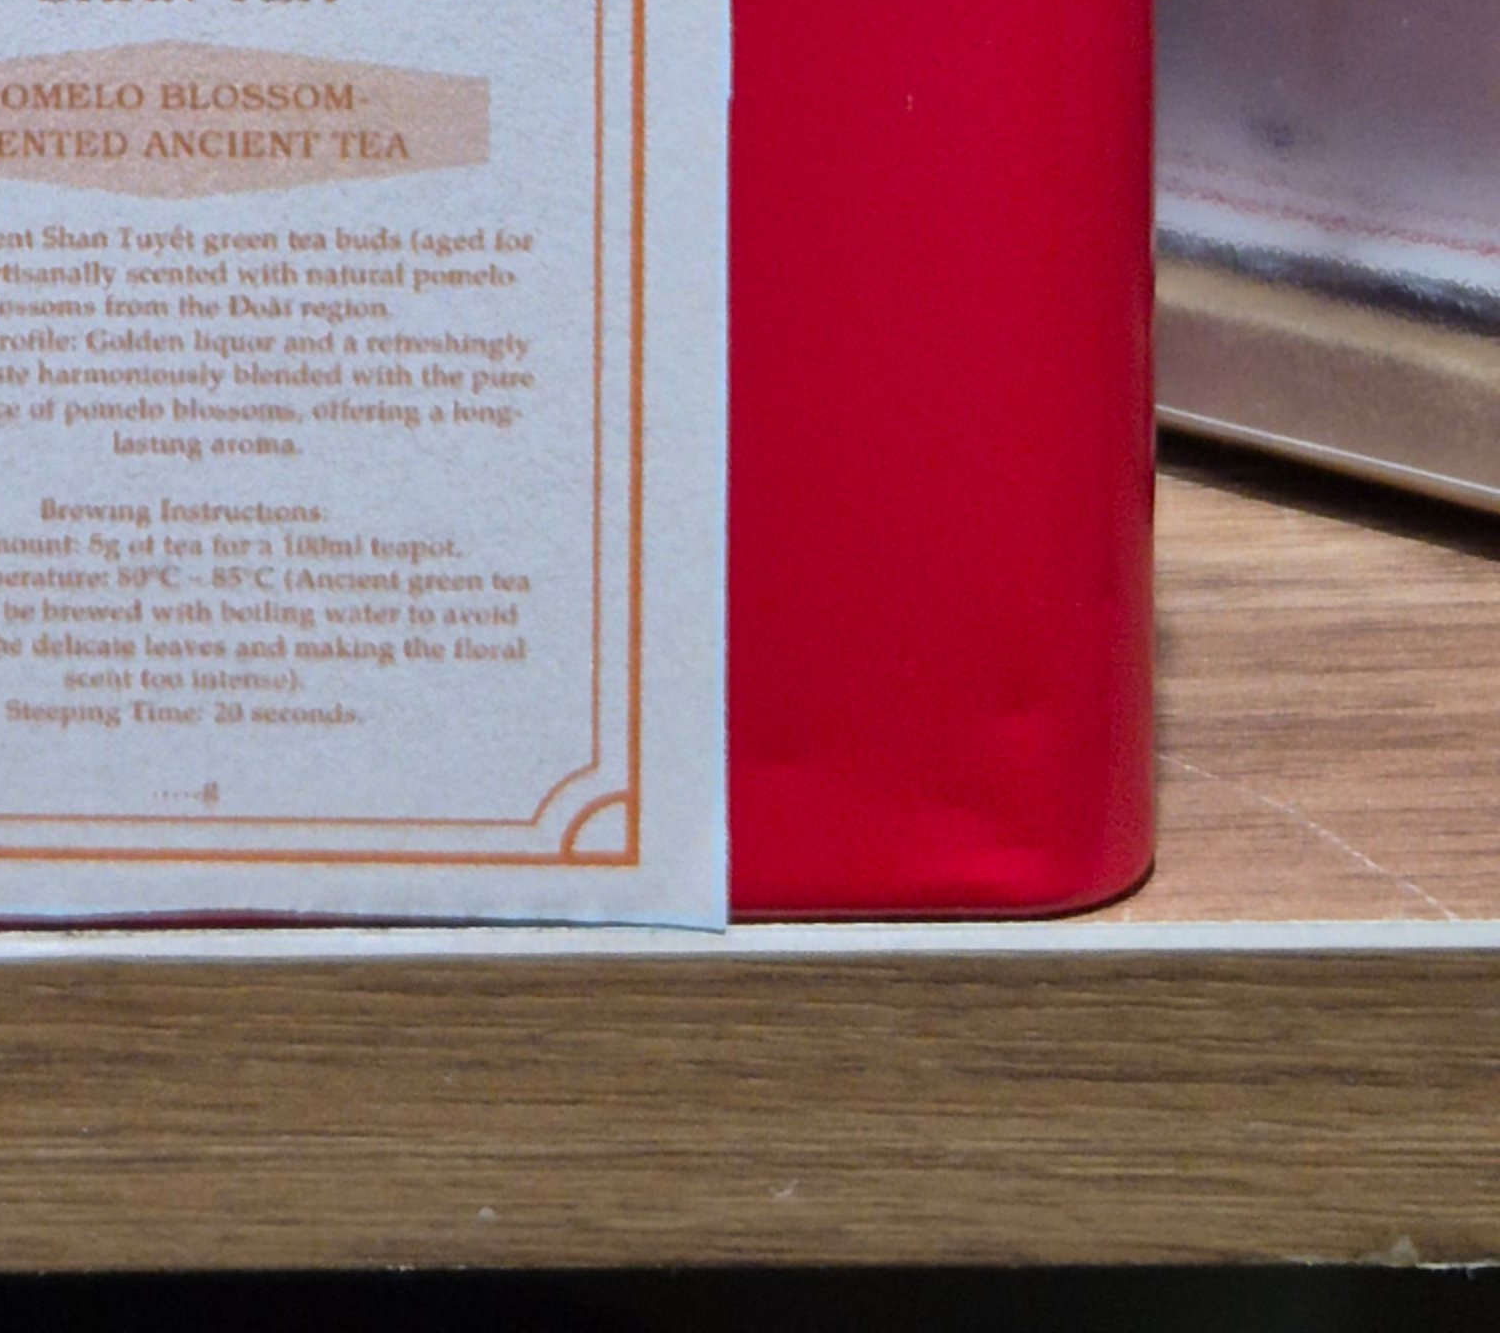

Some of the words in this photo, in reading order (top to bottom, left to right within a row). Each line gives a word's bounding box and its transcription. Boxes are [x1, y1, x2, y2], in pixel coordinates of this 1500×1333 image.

[159, 82, 371, 112] BLOSSOM-
[143, 129, 320, 160] ANCIENT
[336, 130, 411, 160] TEA
[42, 227, 109, 252] Shan
[204, 233, 278, 259] green
[288, 227, 327, 252] tea
[335, 228, 402, 253] buds
[410, 228, 485, 260] (aged
[494, 228, 534, 253] for
[125, 259, 227, 284] scented
[238, 260, 298, 285] with
[306, 260, 404, 285] natural
[413, 261, 516, 293] pomelo
[105, 293, 168, 318] from
[179, 293, 220, 318] the
[86, 328, 184, 353] Golden
[194, 329, 275, 361] liquor
[284, 329, 333, 354] and
[344, 335, 357, 354] a
[367, 330, 528, 362] refreshingly
[38, 361, 222, 393] harmoniously
[234, 362, 342, 387] blended
[353, 362, 412, 387] with
[422, 363, 464, 388] the
[471, 369, 534, 395] pure
[30, 396, 53, 421] of
[65, 396, 164, 428] pomelo
[312, 397, 420, 429] offering
[430, 404, 443, 423] a
[113, 431, 201, 463] lasting
[41, 498, 151, 530] Brewing
[128, 532, 154, 557] of
[164, 532, 202, 557] tea
[213, 533, 254, 558] for
[259, 539, 272, 558] a
[371, 534, 462, 566] teapot.
[283, 567, 400, 596] (Ancient
[408, 574, 483, 600] green
[492, 568, 531, 593] tea
[3, 598, 34, 623] be
[43, 599, 141, 624] brewed
[152, 599, 212, 624] with
[221, 600, 315, 632] boiling
[325, 601, 400, 626] water
[408, 601, 435, 626] to
[443, 602, 518, 627] avoid
[32, 633, 136, 658] delicate
[145, 633, 226, 658] leaves
[236, 634, 286, 659] and
[295, 635, 394, 667] making
[404, 635, 445, 660] the
[454, 636, 526, 661] floral
[64, 666, 132, 691] scent
[141, 666, 183, 691] too
[5, 699, 120, 731] Steeping
[214, 699, 243, 724] 20
